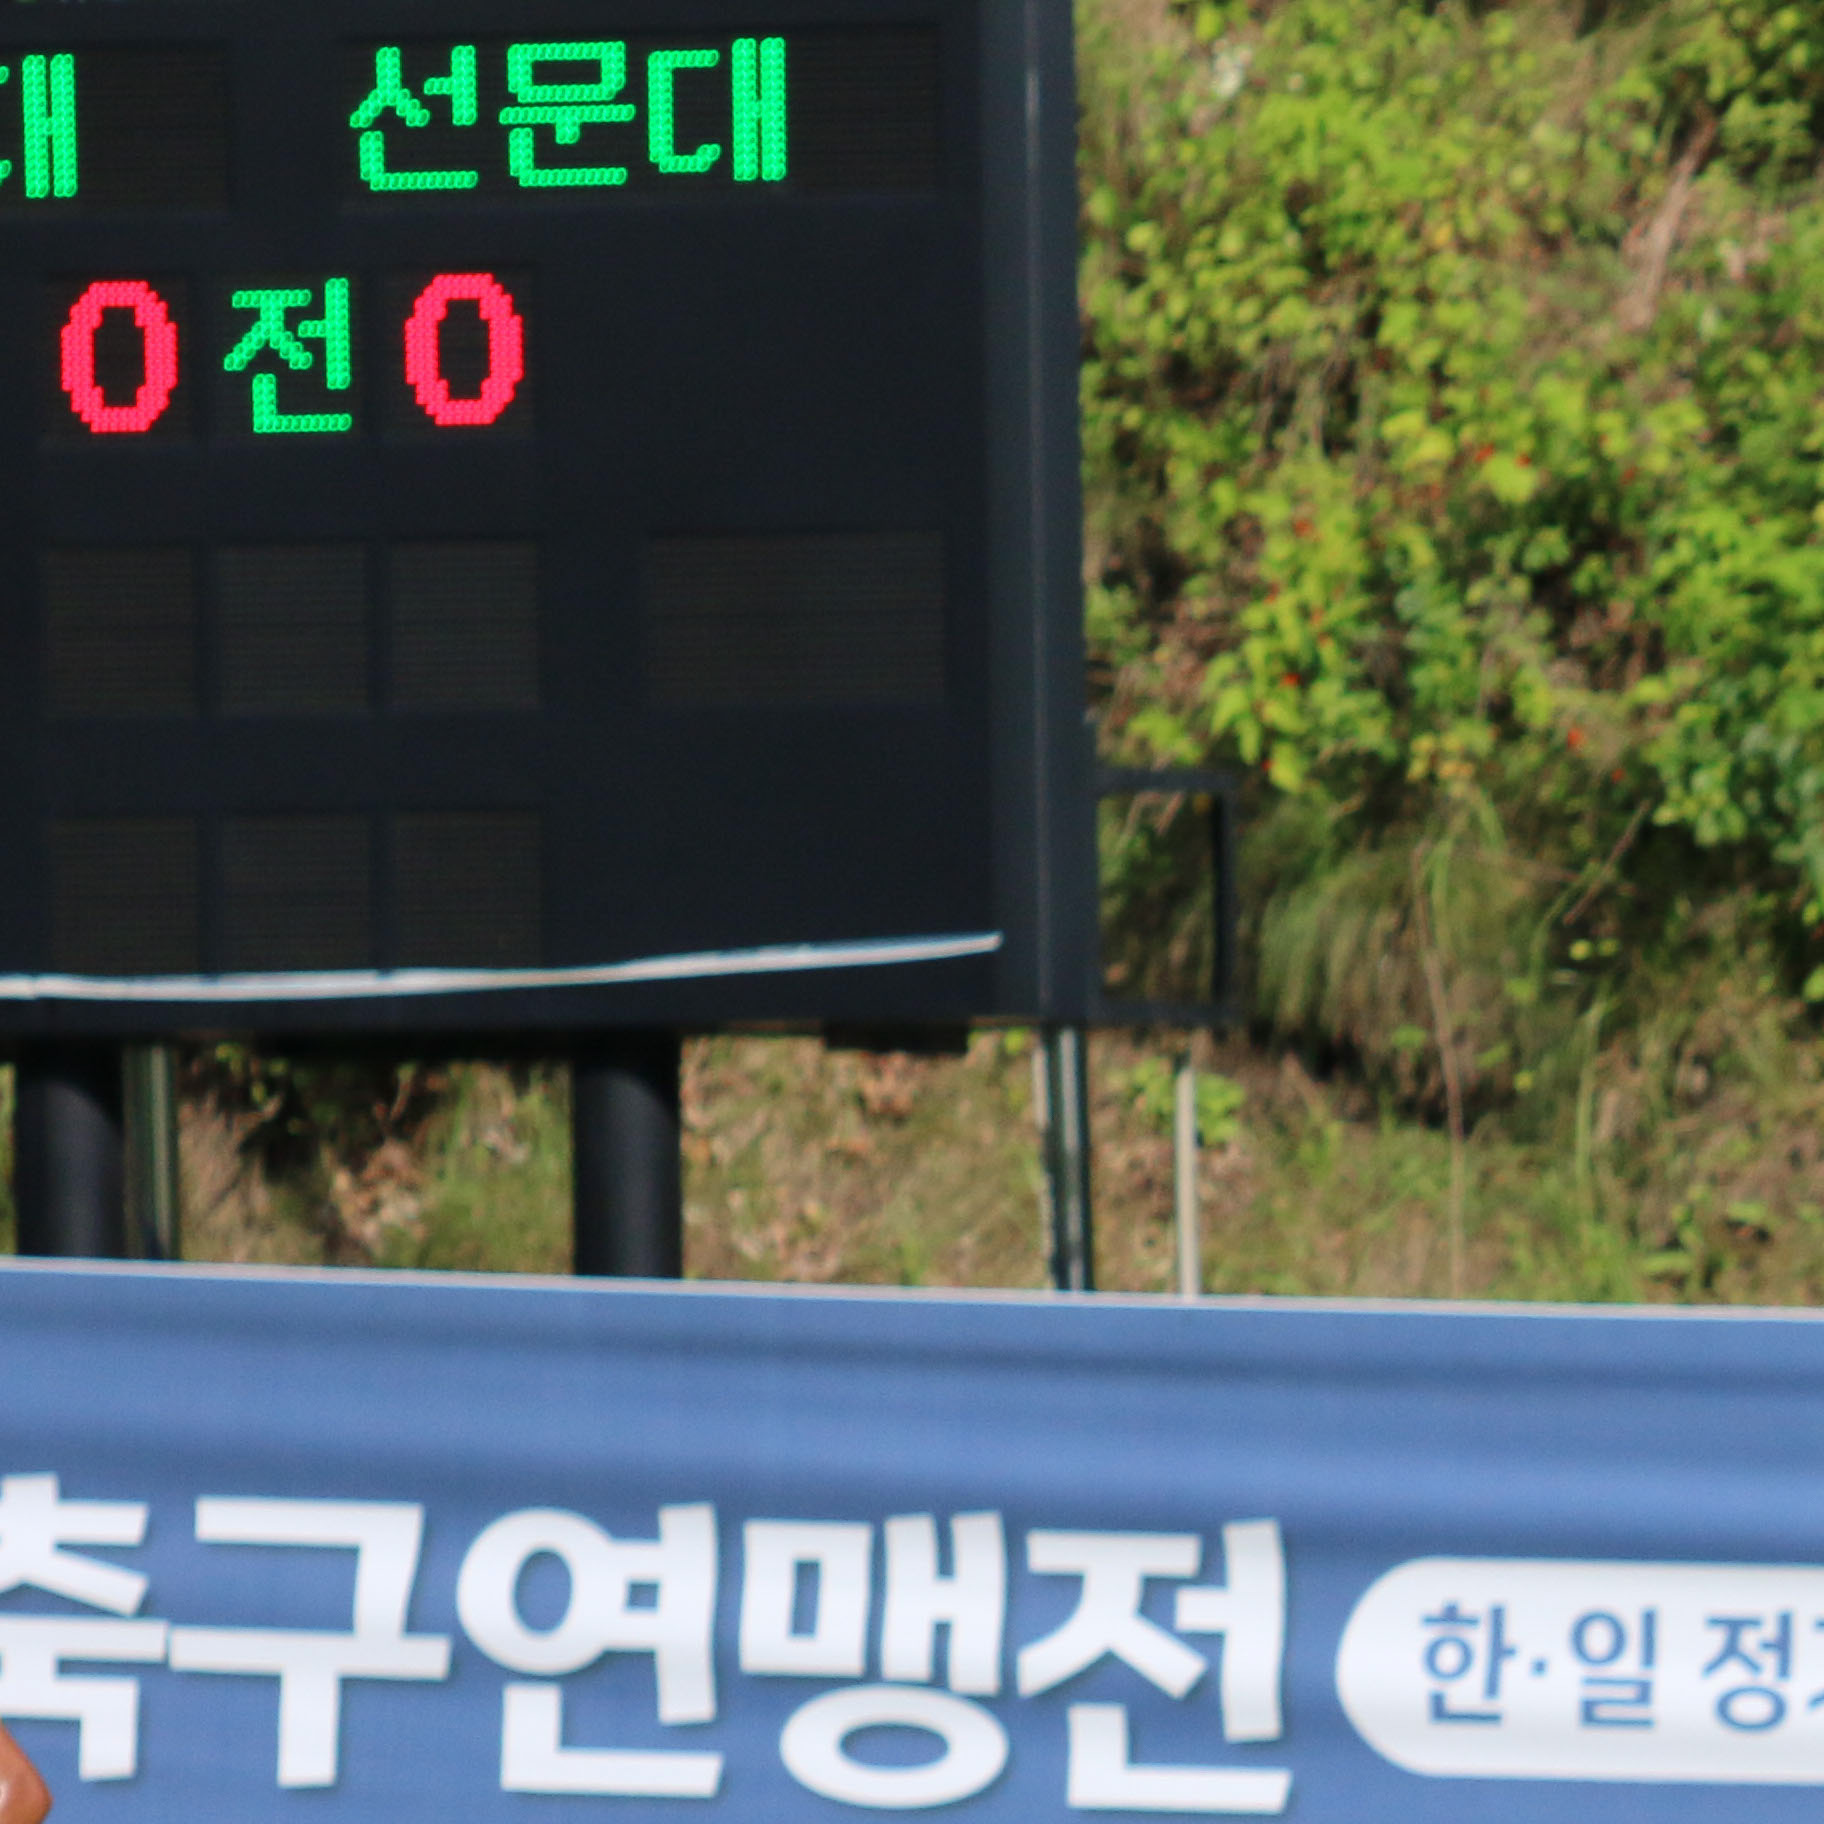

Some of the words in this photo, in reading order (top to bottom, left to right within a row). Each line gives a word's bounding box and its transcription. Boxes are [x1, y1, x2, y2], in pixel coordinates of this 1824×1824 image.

[349, 37, 787, 191] 선문대
[60, 280, 179, 433] 0
[223, 277, 352, 434] 전
[403, 272, 525, 427] 0
[0, 1471, 1292, 1815] 축구연맹전
[1422, 1602, 1658, 1729] 한·일
